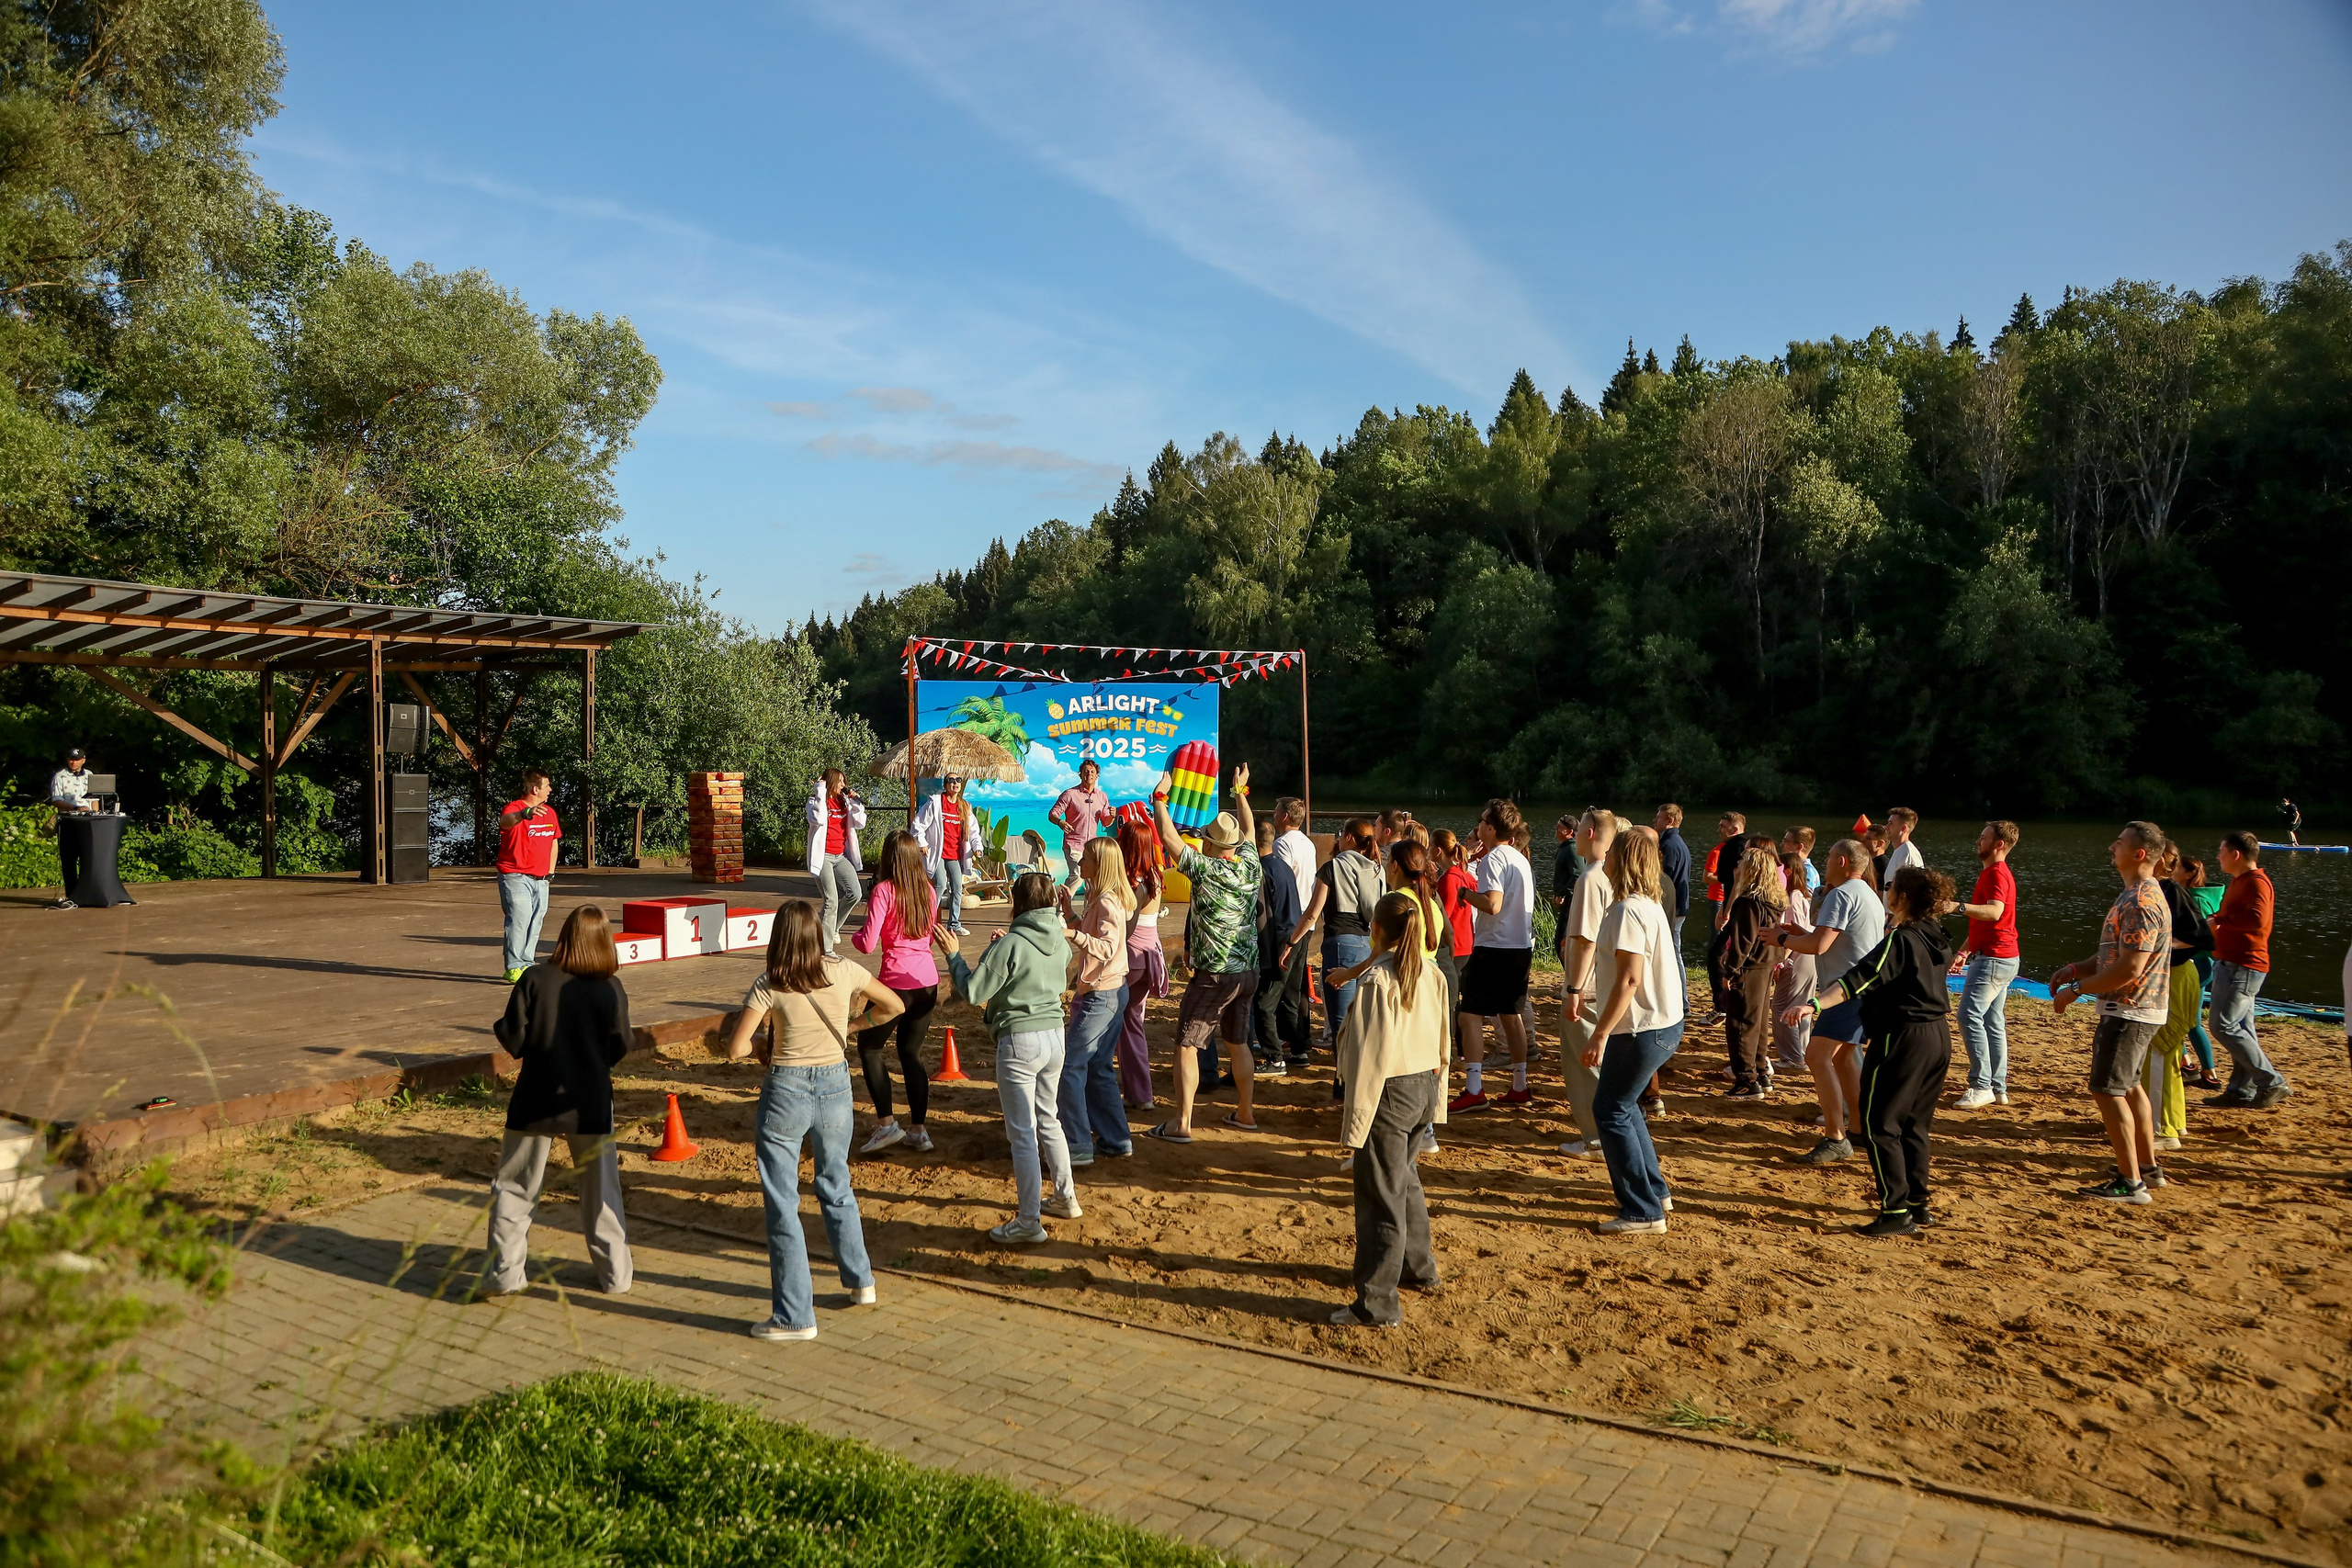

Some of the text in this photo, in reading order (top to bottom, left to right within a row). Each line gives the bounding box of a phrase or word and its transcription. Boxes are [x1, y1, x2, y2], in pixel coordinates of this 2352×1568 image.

[1068, 694, 1160, 716] ARLIGHT
[1079, 738, 1147, 759] 2025
[691, 915, 703, 942] 1
[747, 919, 758, 942] 2
[629, 943, 639, 960] 3
